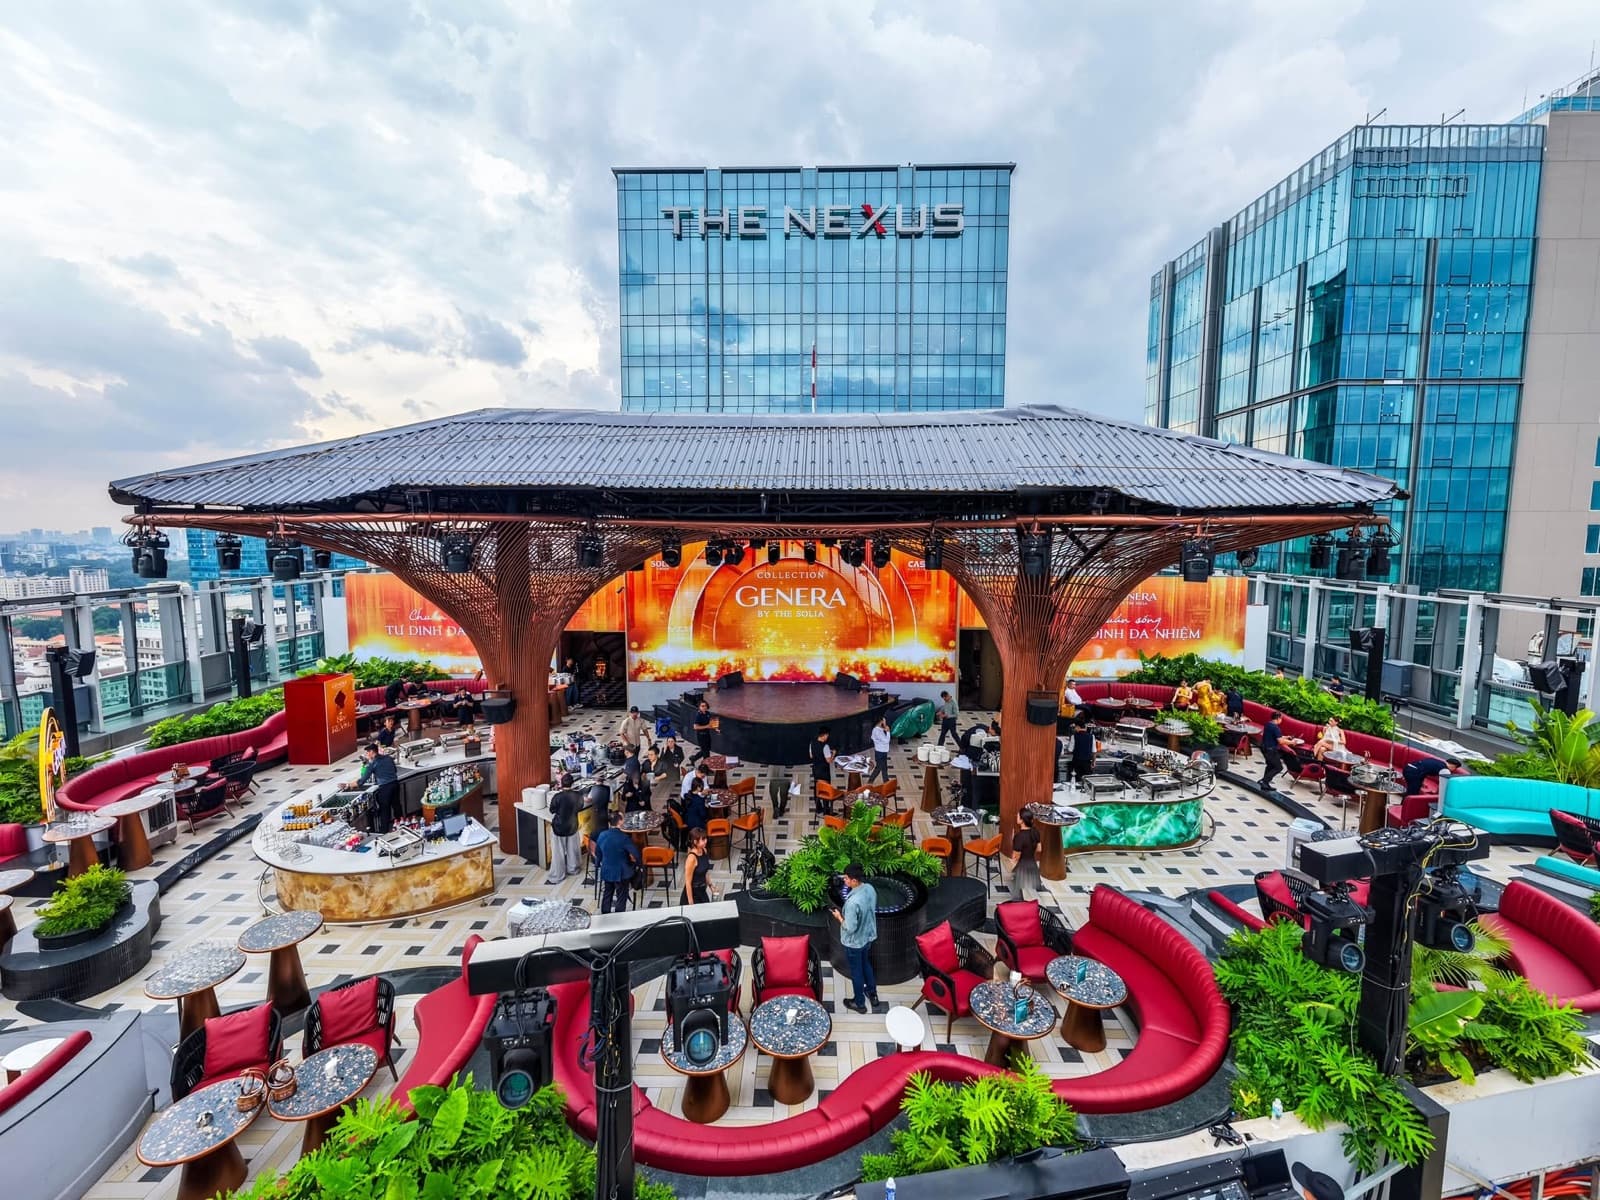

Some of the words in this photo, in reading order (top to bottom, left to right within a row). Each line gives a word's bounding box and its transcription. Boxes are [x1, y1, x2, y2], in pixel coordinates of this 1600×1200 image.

[661, 205, 767, 236] THE
[784, 203, 965, 235] NEXUS
[757, 571, 824, 579] COLLECTION
[735, 585, 847, 609] GENERA
[758, 610, 770, 618] BY
[774, 610, 792, 618] THE
[796, 610, 824, 618] SOLIA
[1155, 627, 1201, 641] NHIỆM
